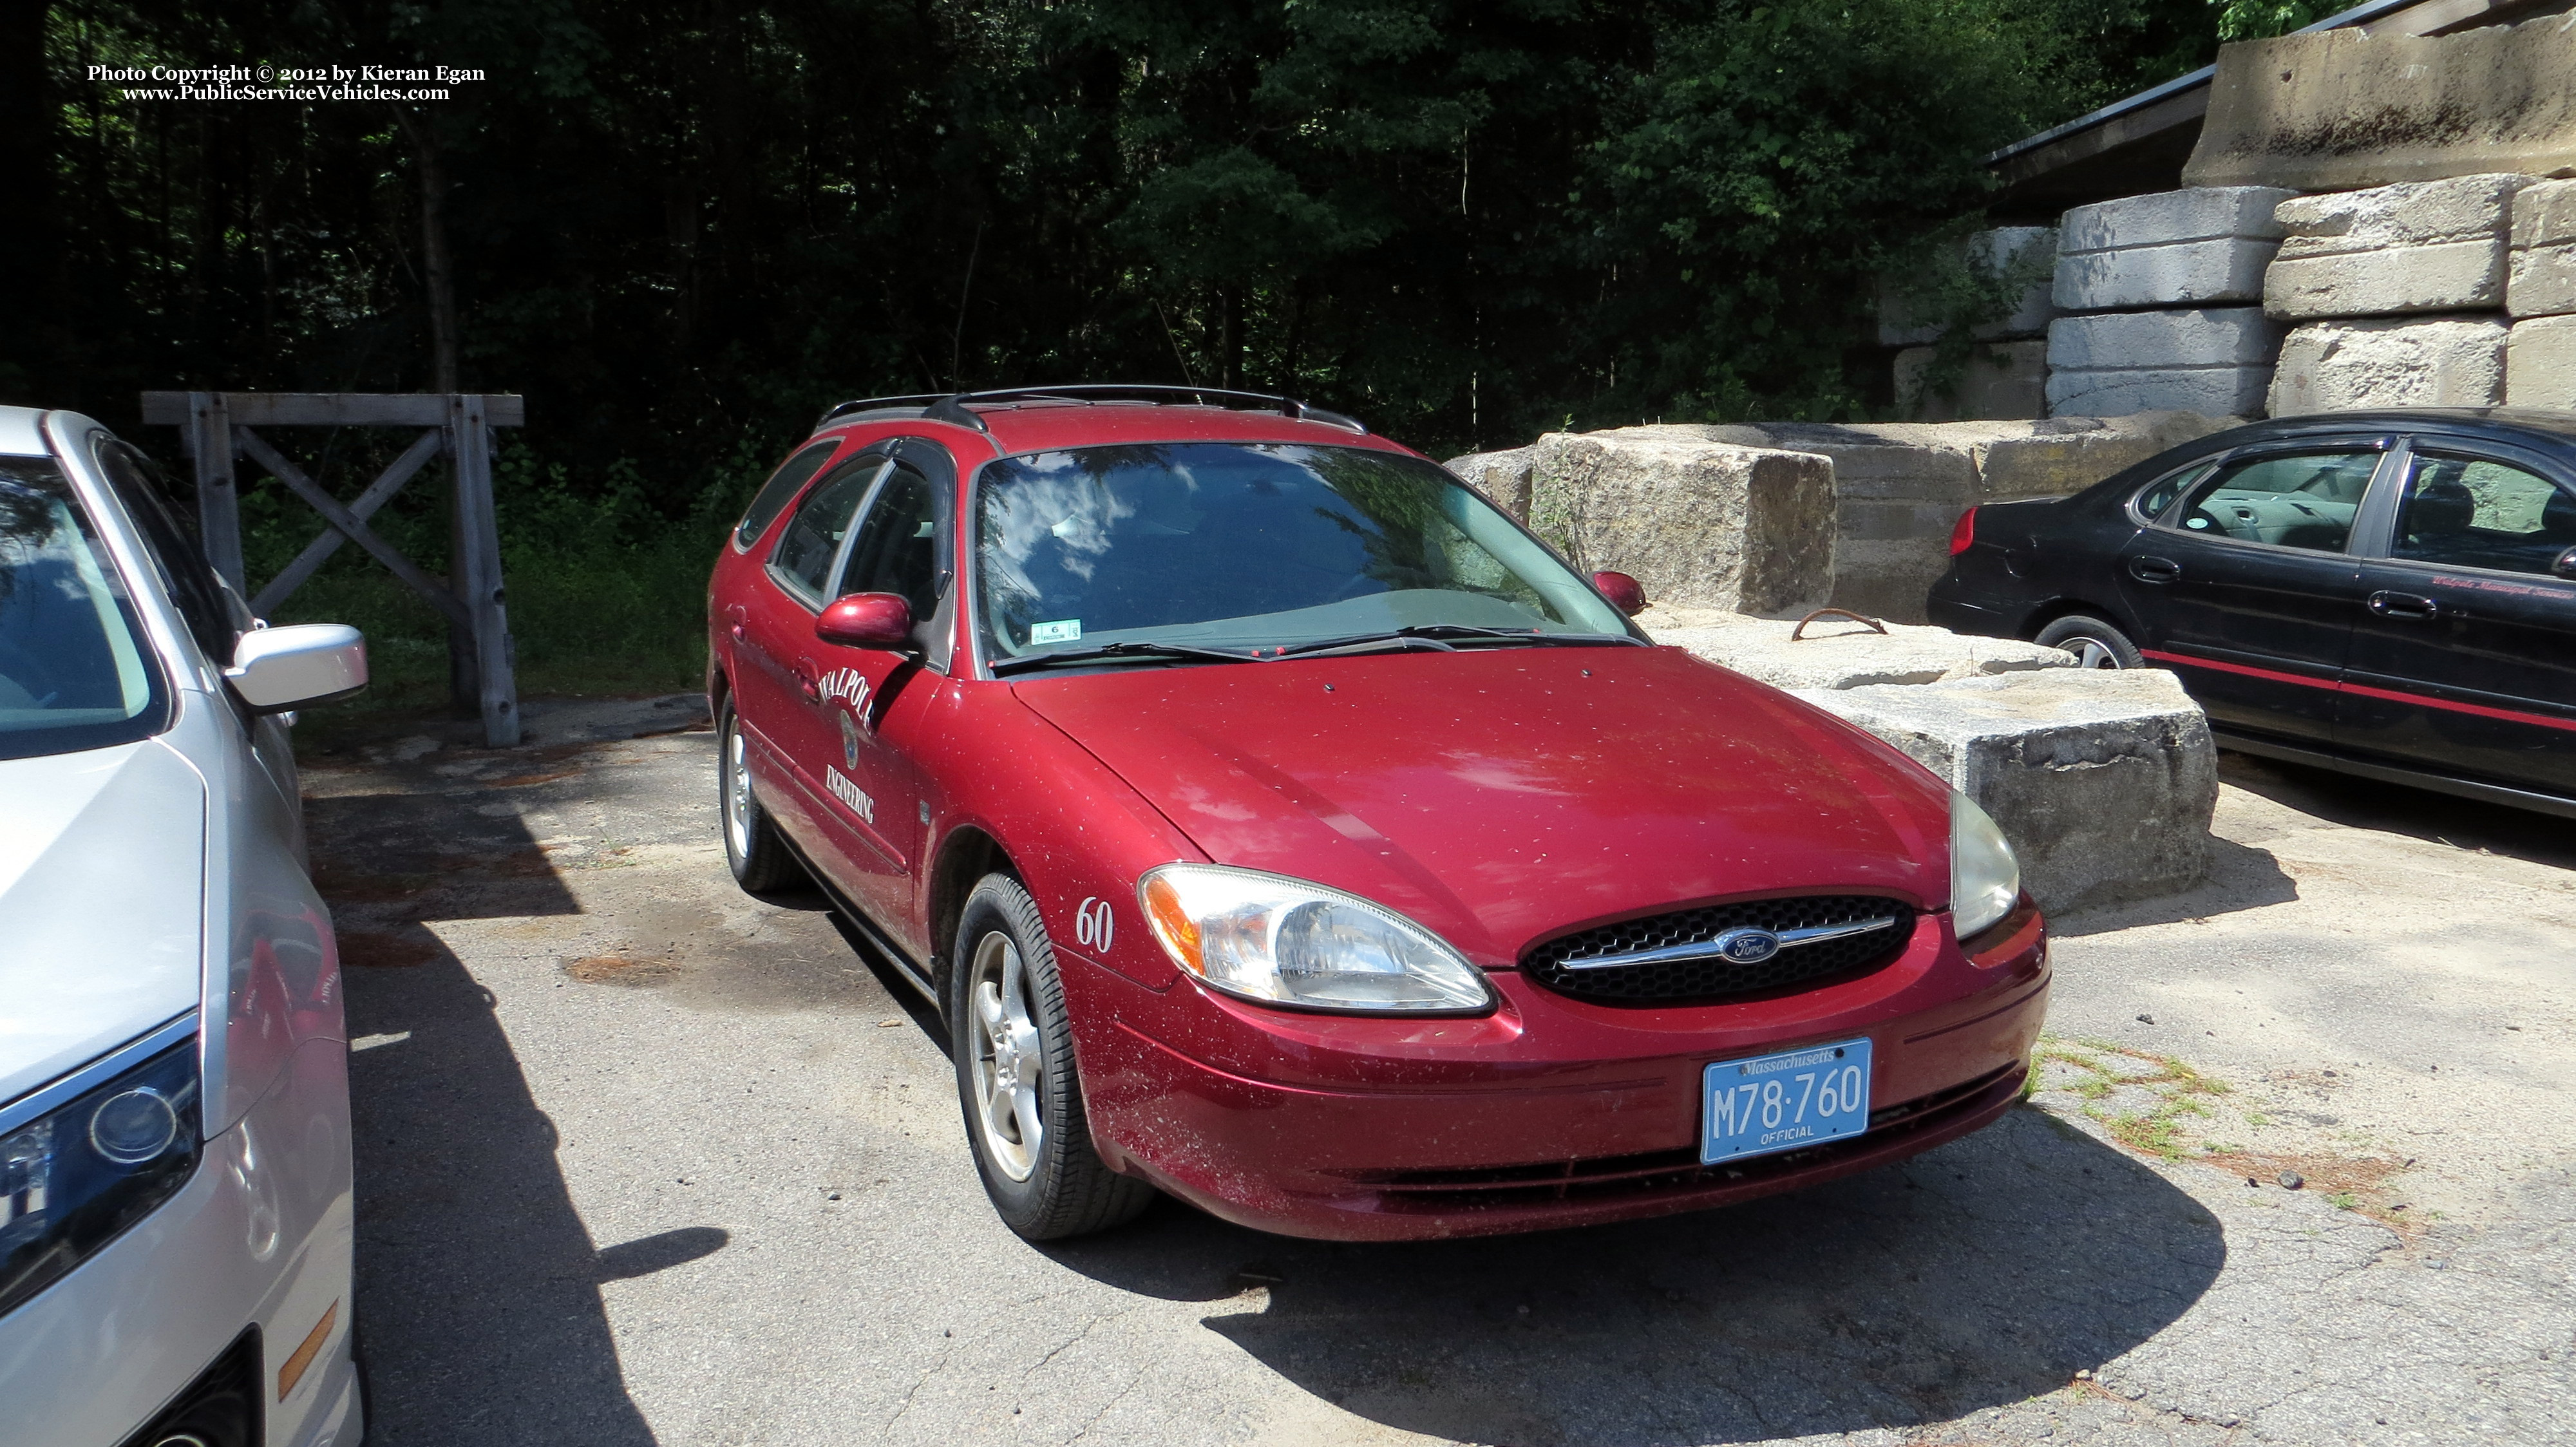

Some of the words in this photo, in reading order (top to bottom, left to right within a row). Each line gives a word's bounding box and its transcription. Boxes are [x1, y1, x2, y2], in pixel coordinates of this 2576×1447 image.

[818, 667, 874, 736] WALPOLE
[826, 763, 874, 824] ENGINEERING
[1076, 896, 1113, 953] 60
[1734, 938, 1766, 956] Ford
[1743, 1049, 1835, 1077] Massachusetts
[1761, 1125, 1814, 1145] OFFICIAL
